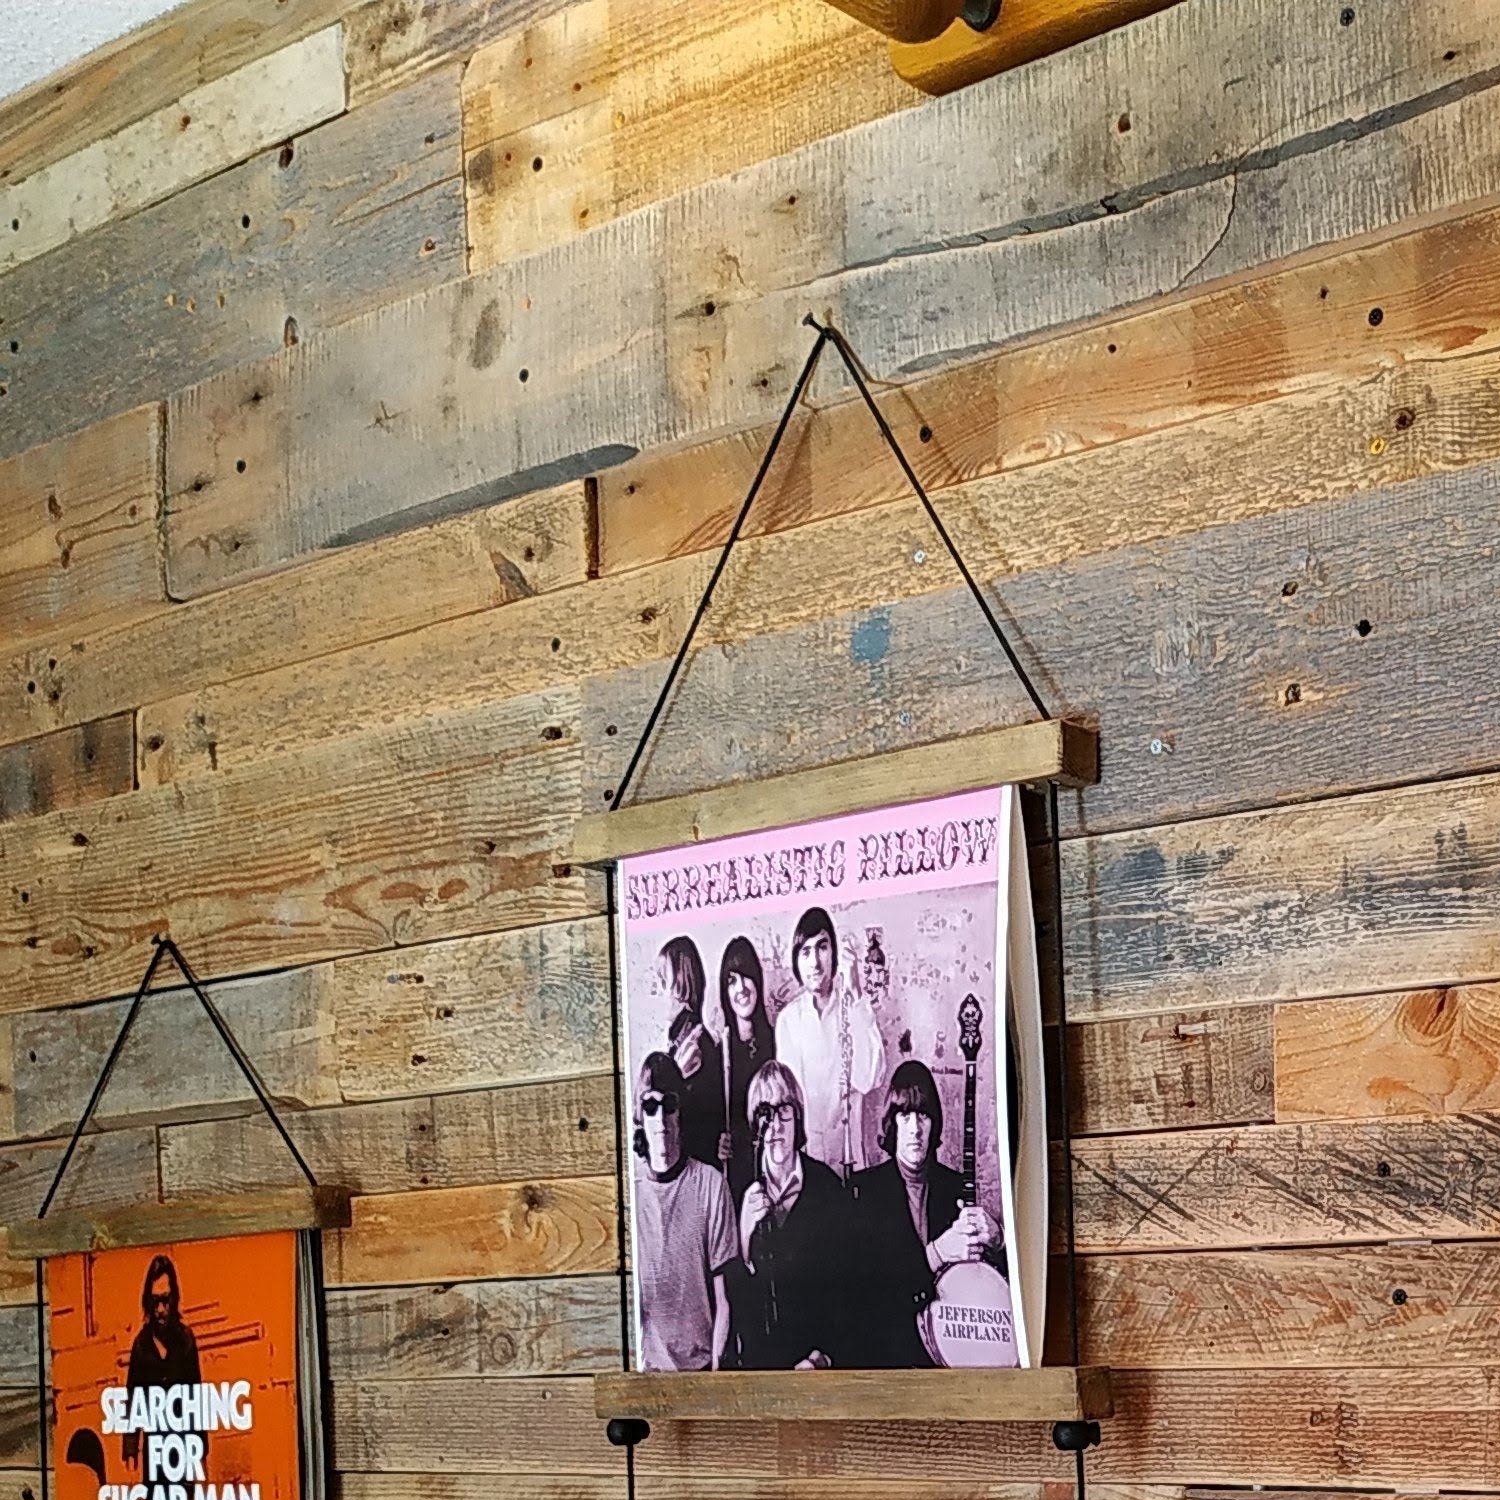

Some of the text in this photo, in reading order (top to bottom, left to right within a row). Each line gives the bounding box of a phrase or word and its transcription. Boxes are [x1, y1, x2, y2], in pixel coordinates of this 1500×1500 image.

[626, 815, 998, 920] SURREALISTIC PILLOW
[938, 1305, 1012, 1326] JEFFERSON
[942, 1323, 1011, 1343] AIRPLANE
[100, 1380, 253, 1435] SEARCHING
[147, 1434, 206, 1483] FOR
